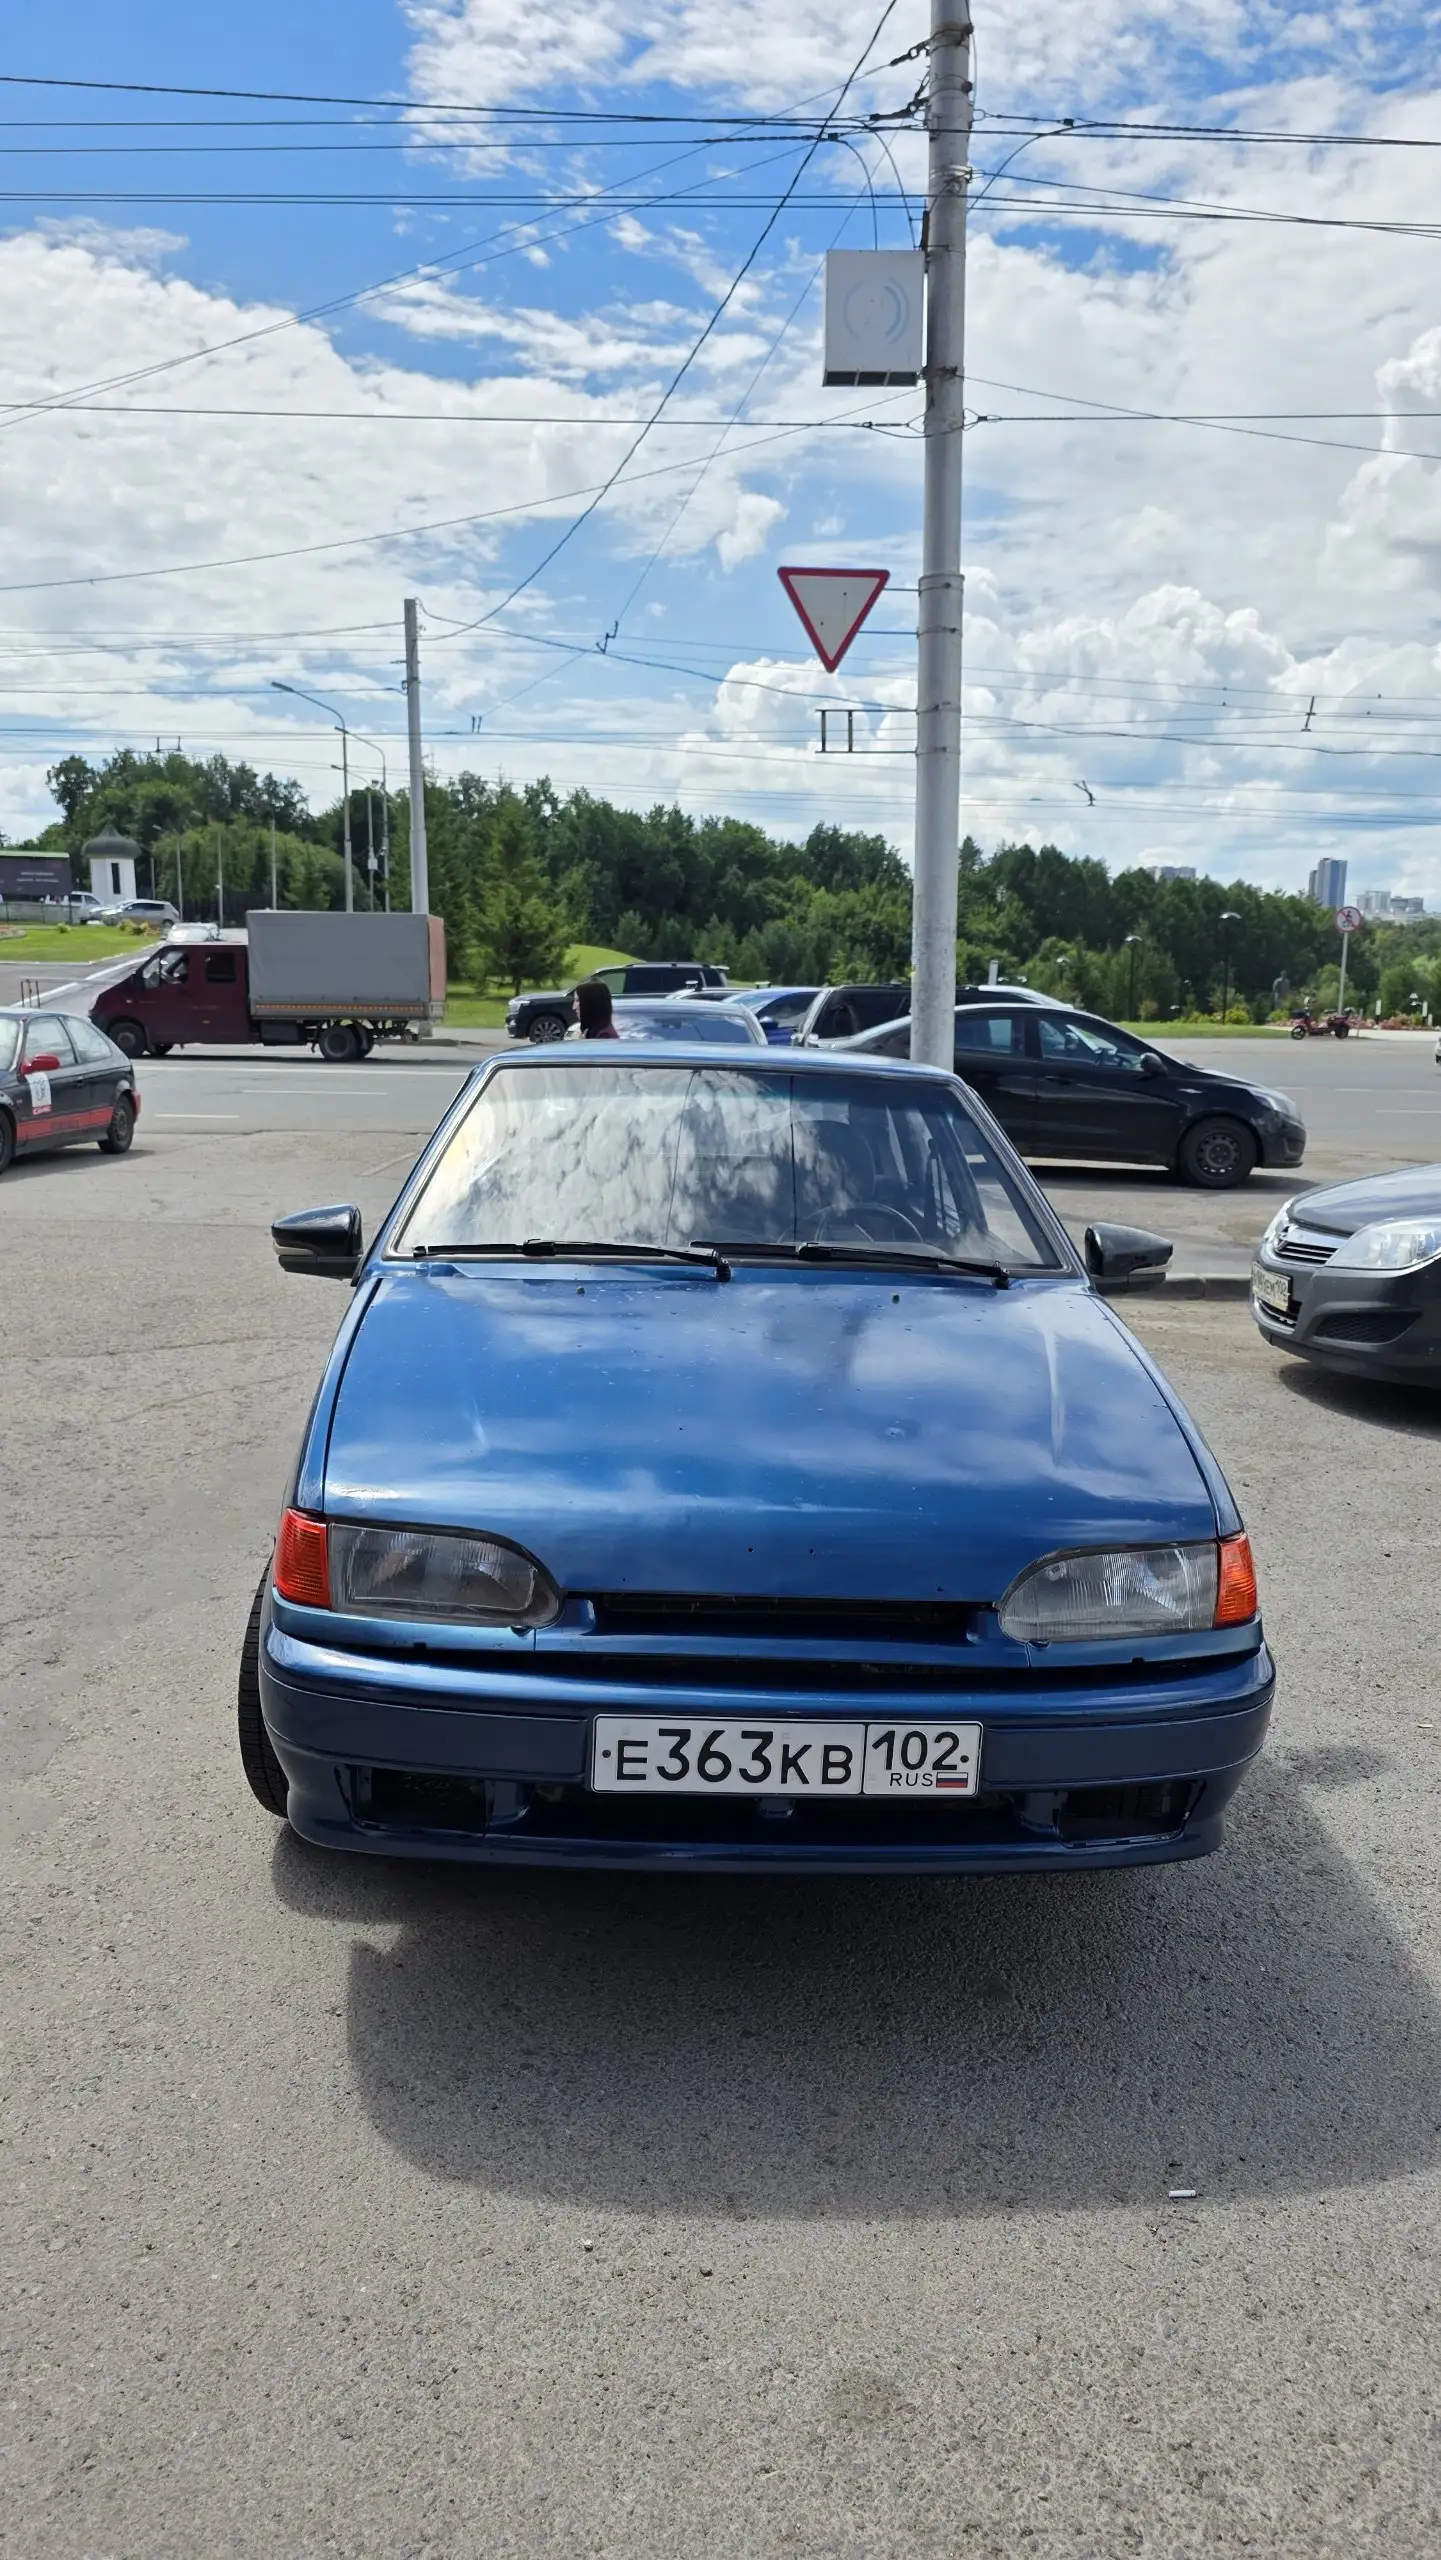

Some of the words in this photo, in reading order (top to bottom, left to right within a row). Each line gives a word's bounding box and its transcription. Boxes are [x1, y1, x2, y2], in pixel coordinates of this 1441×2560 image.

[616, 1728, 853, 1785] Е363КВ
[871, 1730, 960, 1771] 102
[889, 1772, 933, 1787] RUS
